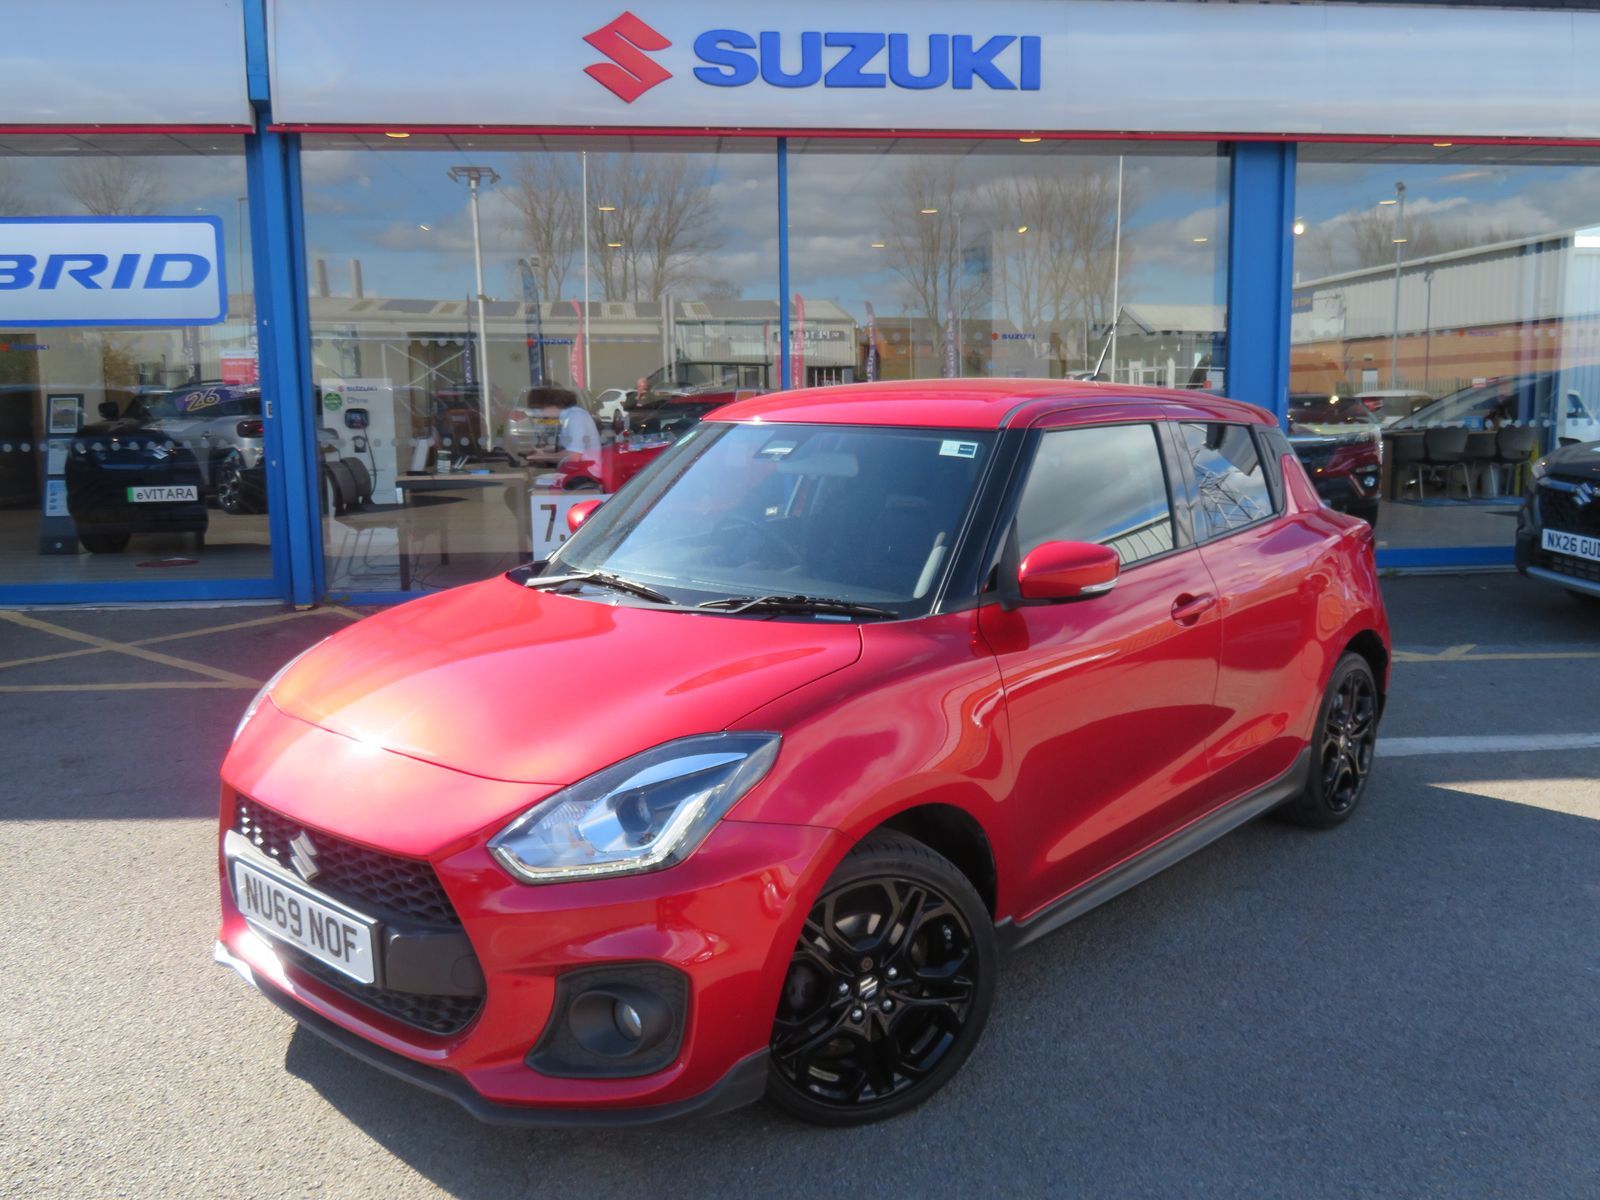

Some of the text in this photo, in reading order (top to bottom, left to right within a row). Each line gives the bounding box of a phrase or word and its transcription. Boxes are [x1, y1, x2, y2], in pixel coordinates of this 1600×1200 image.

[693, 28, 1041, 91] SUZUKI
[185, 387, 220, 411] 26
[136, 487, 195, 500] eVITARA
[1547, 532, 1578, 553] NX26
[244, 873, 358, 963] NU69 NOF
